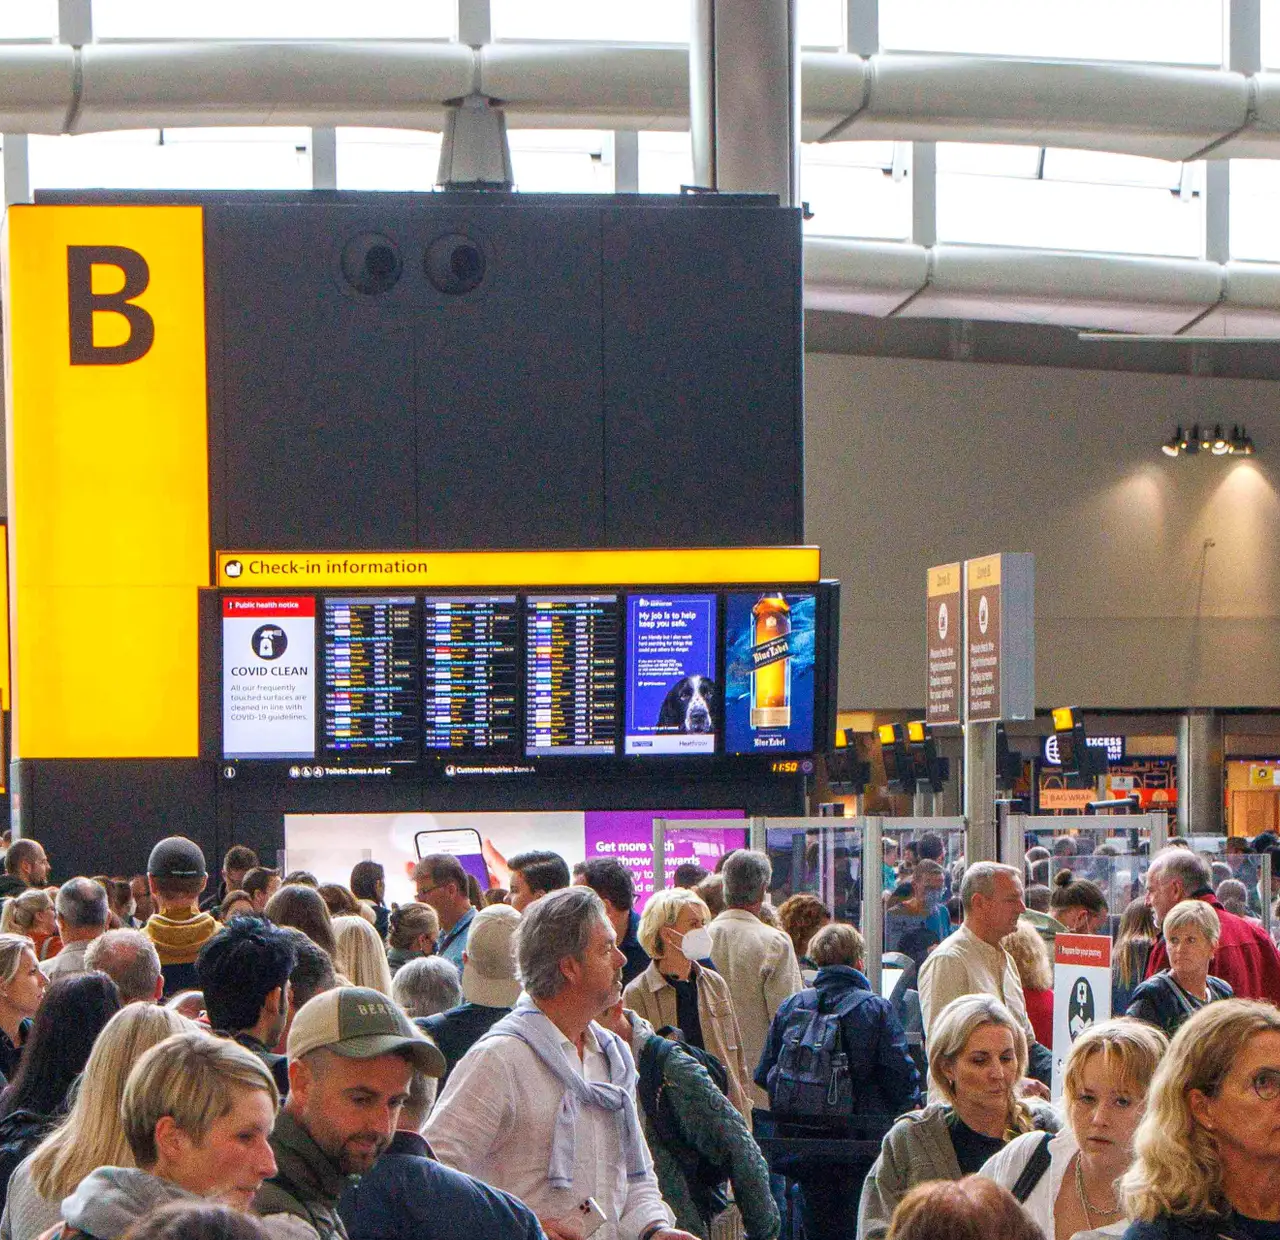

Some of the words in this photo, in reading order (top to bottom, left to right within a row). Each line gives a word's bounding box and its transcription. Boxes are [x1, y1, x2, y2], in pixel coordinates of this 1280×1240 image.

[66, 244, 155, 367] B
[249, 560, 321, 575] Check-in
[326, 559, 428, 574] information
[639, 612, 649, 620] My
[651, 612, 662, 620] job
[681, 611, 697, 620] help
[638, 620, 655, 628] keep
[231, 667, 268, 676] COVID
[270, 667, 308, 676] CLEAN
[257, 684, 296, 692] frequently
[772, 760, 799, 772] 11:50
[596, 841, 616, 852] Get
[618, 842, 646, 852] more
[649, 841, 675, 852] wth
